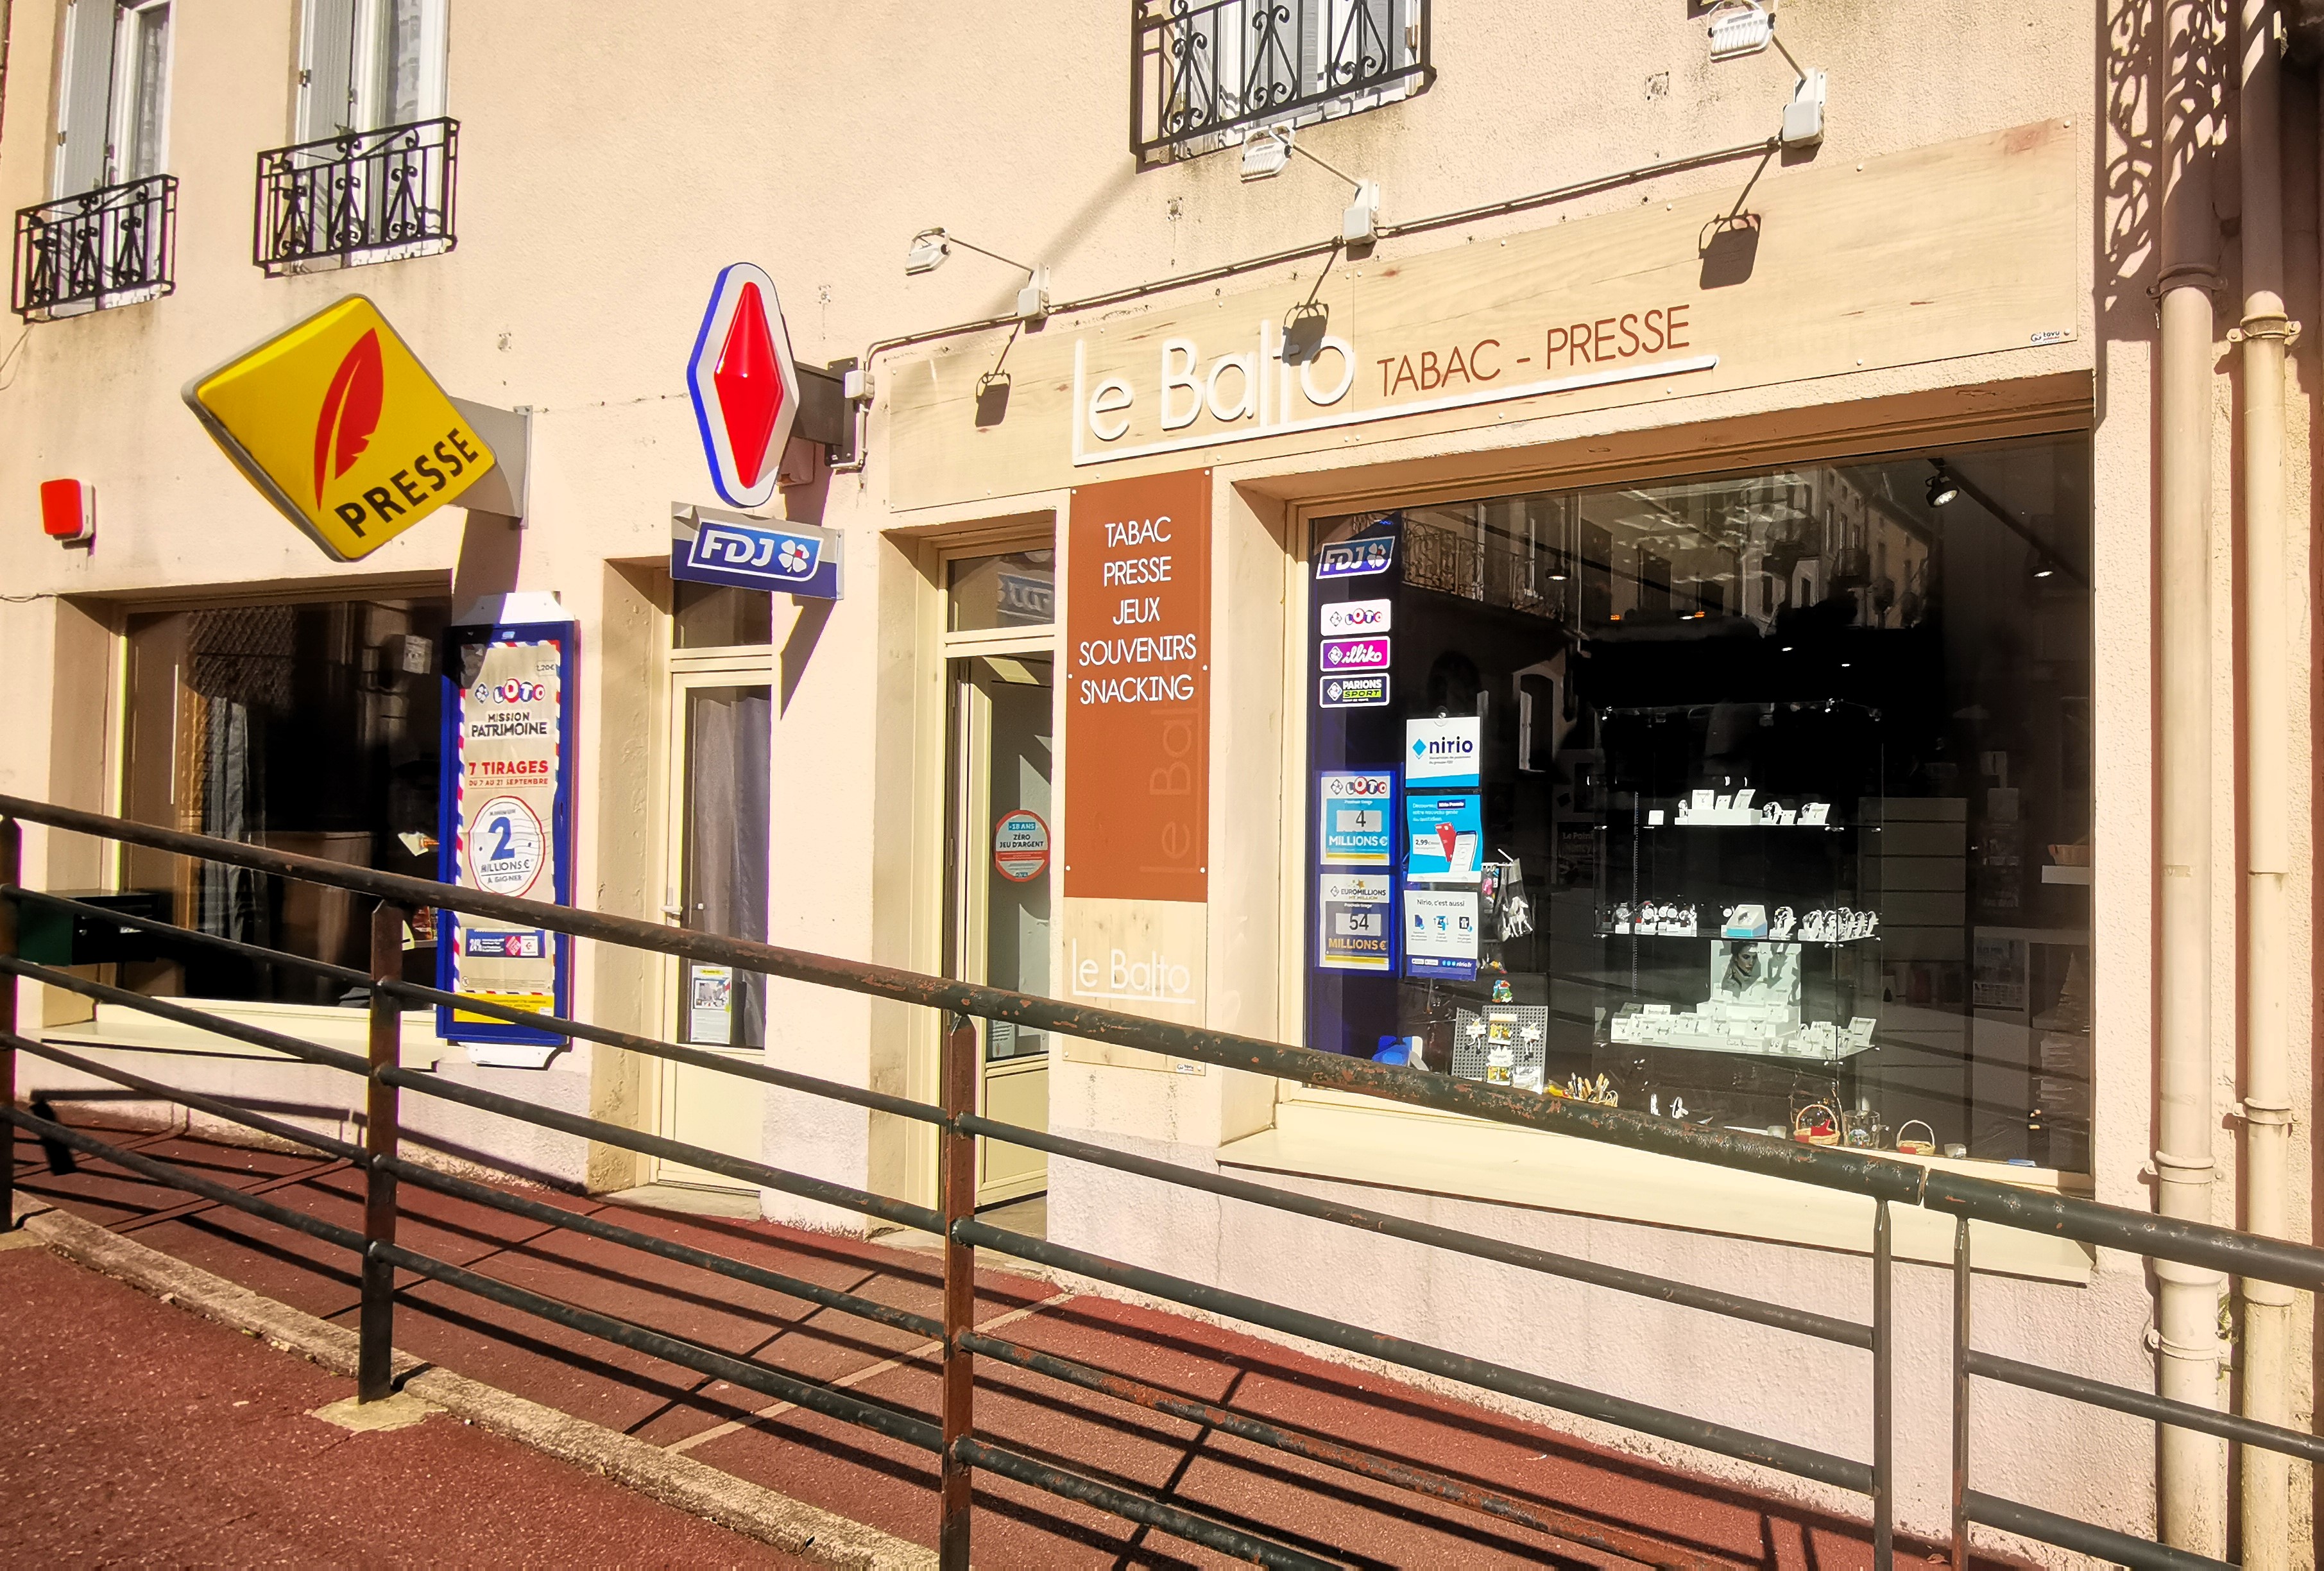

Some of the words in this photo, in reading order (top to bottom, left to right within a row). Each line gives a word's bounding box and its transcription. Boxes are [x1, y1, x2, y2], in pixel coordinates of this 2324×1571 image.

[1073, 338, 1134, 465] le
[1160, 319, 1355, 431] Balto
[1376, 339, 1501, 397] TABAC
[1546, 304, 1690, 370] PRESSE
[334, 427, 479, 539] PRESSE
[1104, 516, 1172, 548] TABAC
[701, 529, 774, 567] FDJ
[1322, 545, 1365, 572] FDJ
[1104, 556, 1172, 587] PRESSE
[1113, 597, 1161, 625] JEUX
[1345, 608, 1383, 626] LOTO
[1079, 633, 1197, 666] SOUVENIRS
[1341, 643, 1383, 664] illiko
[493, 678, 545, 703] LOTO
[1080, 674, 1194, 705] SNACKING
[1342, 679, 1382, 690] PARIONS
[488, 712, 530, 723] MISSION
[471, 722, 548, 737] PATRIMOINE
[1429, 735, 1473, 754] nirio
[468, 762, 477, 776] 7
[482, 760, 549, 775] TIRAGES
[1346, 776, 1387, 795] LOTO
[1355, 809, 1367, 827] 4
[488, 816, 515, 861] 2
[1013, 832, 1030, 841] ZÉRO
[1328, 835, 1379, 846] MILLIONS
[1380, 836, 1388, 846] €
[481, 861, 522, 873] MILLIONS
[523, 859, 530, 869] €
[1349, 913, 1369, 931] 54
[1328, 938, 1379, 950] MILLIONS
[1379, 940, 1387, 951] €
[1072, 938, 1099, 995] le
[1111, 949, 1191, 996] Balto
